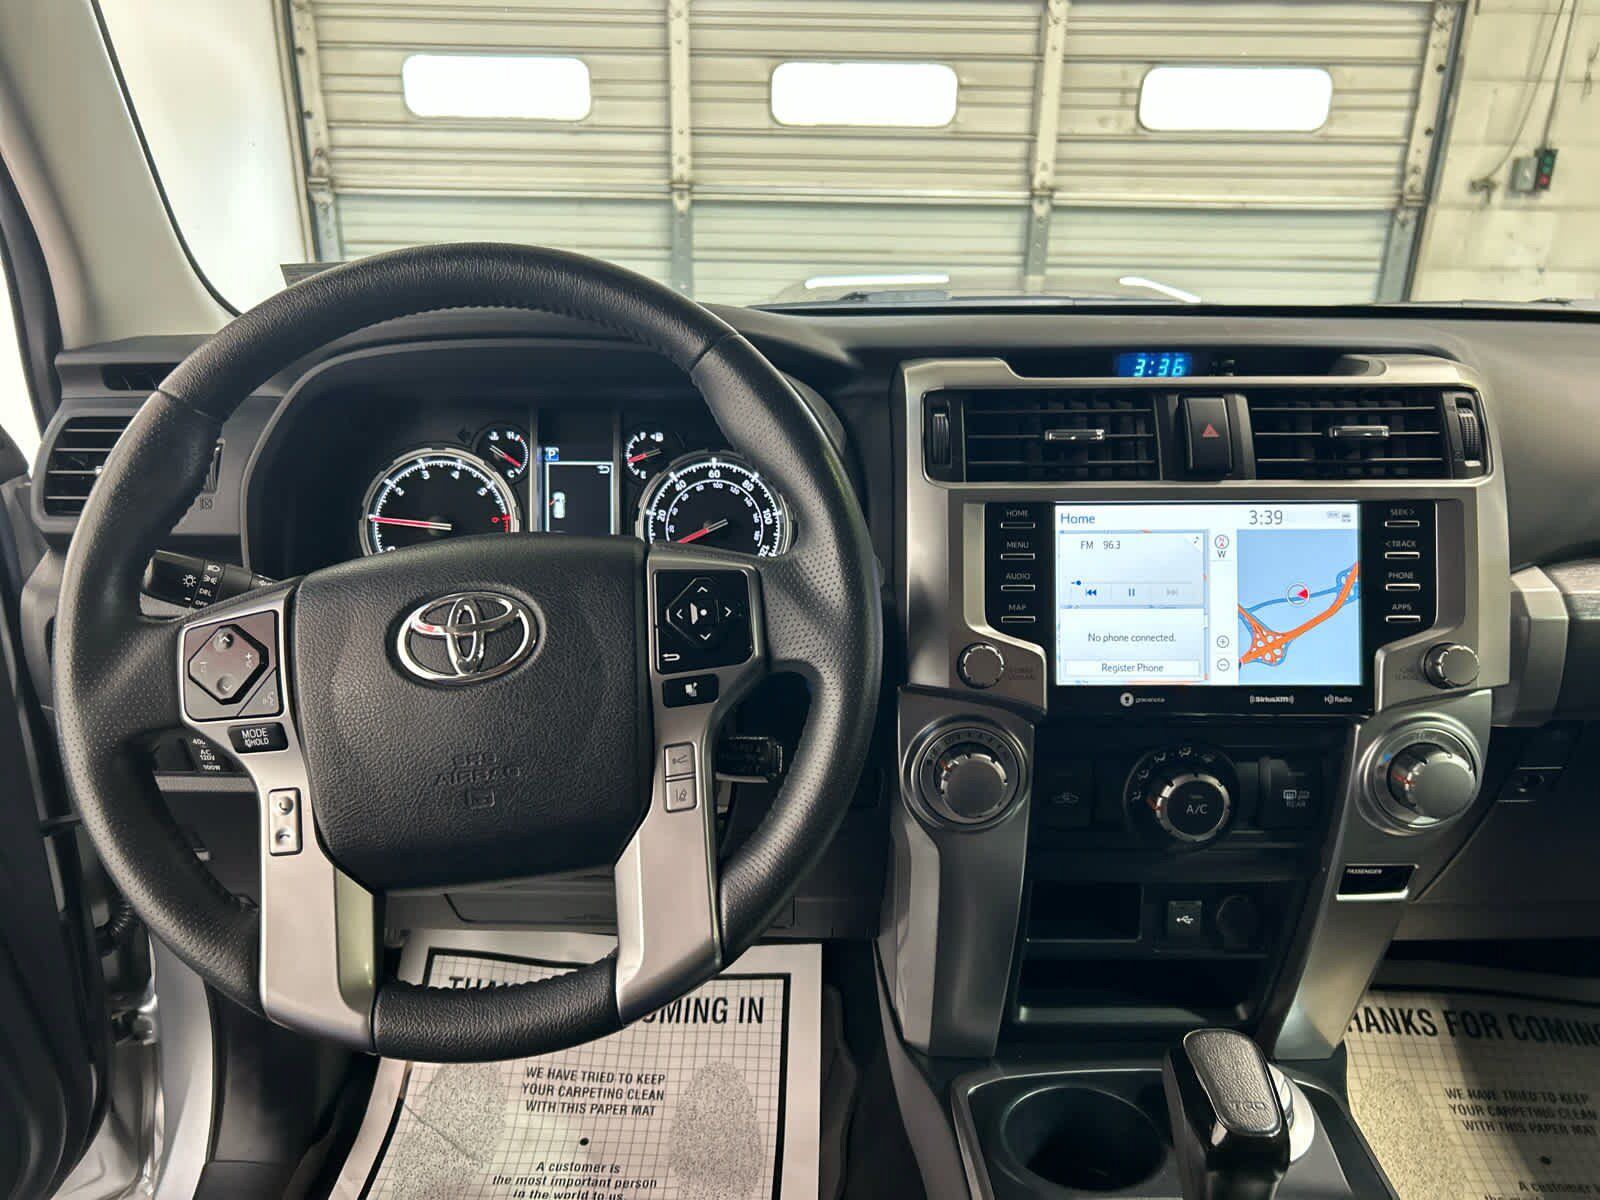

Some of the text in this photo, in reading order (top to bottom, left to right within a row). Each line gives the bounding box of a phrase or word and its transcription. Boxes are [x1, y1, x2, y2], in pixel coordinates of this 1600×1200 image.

[1134, 358, 1185, 377] 3:36
[548, 449, 556, 460] P
[422, 470, 431, 480] 3
[451, 471, 460, 480] 4
[507, 470, 515, 478] C
[708, 469, 721, 479] 60
[395, 487, 405, 496] 2
[477, 487, 488, 496] 5
[674, 480, 687, 492] 40
[741, 480, 755, 492] 80
[657, 509, 667, 523] 20
[762, 508, 773, 526] 100
[1060, 513, 1096, 524] Home
[1249, 510, 1284, 525] 3:39
[1006, 541, 1029, 549] MENU
[1080, 541, 1121, 550] FM 96.3
[1217, 550, 1226, 558] W
[1006, 572, 1031, 580] AUDIO
[1388, 571, 1414, 580] PHONE
[1008, 603, 1028, 611] MAP
[1392, 603, 1412, 611] APPS
[1088, 632, 1176, 644] No phone connected.
[1101, 663, 1165, 674] Register Phone
[241, 728, 268, 739] MODE
[251, 738, 270, 746] HOLD
[1186, 803, 1208, 815] A/C
[739, 997, 765, 1024] IN
[1443, 1010, 1504, 1039] FOR
[526, 1067, 666, 1085] WE HAVE TRIED TO KEEP
[522, 1083, 665, 1100] YOUR CARPETING CLEAN
[1445, 1087, 1463, 1099] WE
[526, 1100, 657, 1116] WITH THIS PAPER MAT
[1448, 1104, 1483, 1116] YOUR
[1462, 1120, 1495, 1132] WITH
[535, 1162, 621, 1174] A customer is
[493, 1175, 657, 1190] the most important person
[513, 1189, 525, 1199] in
[529, 1189, 549, 1200] the
[553, 1190, 589, 1200] world
[593, 1191, 605, 1200] to
